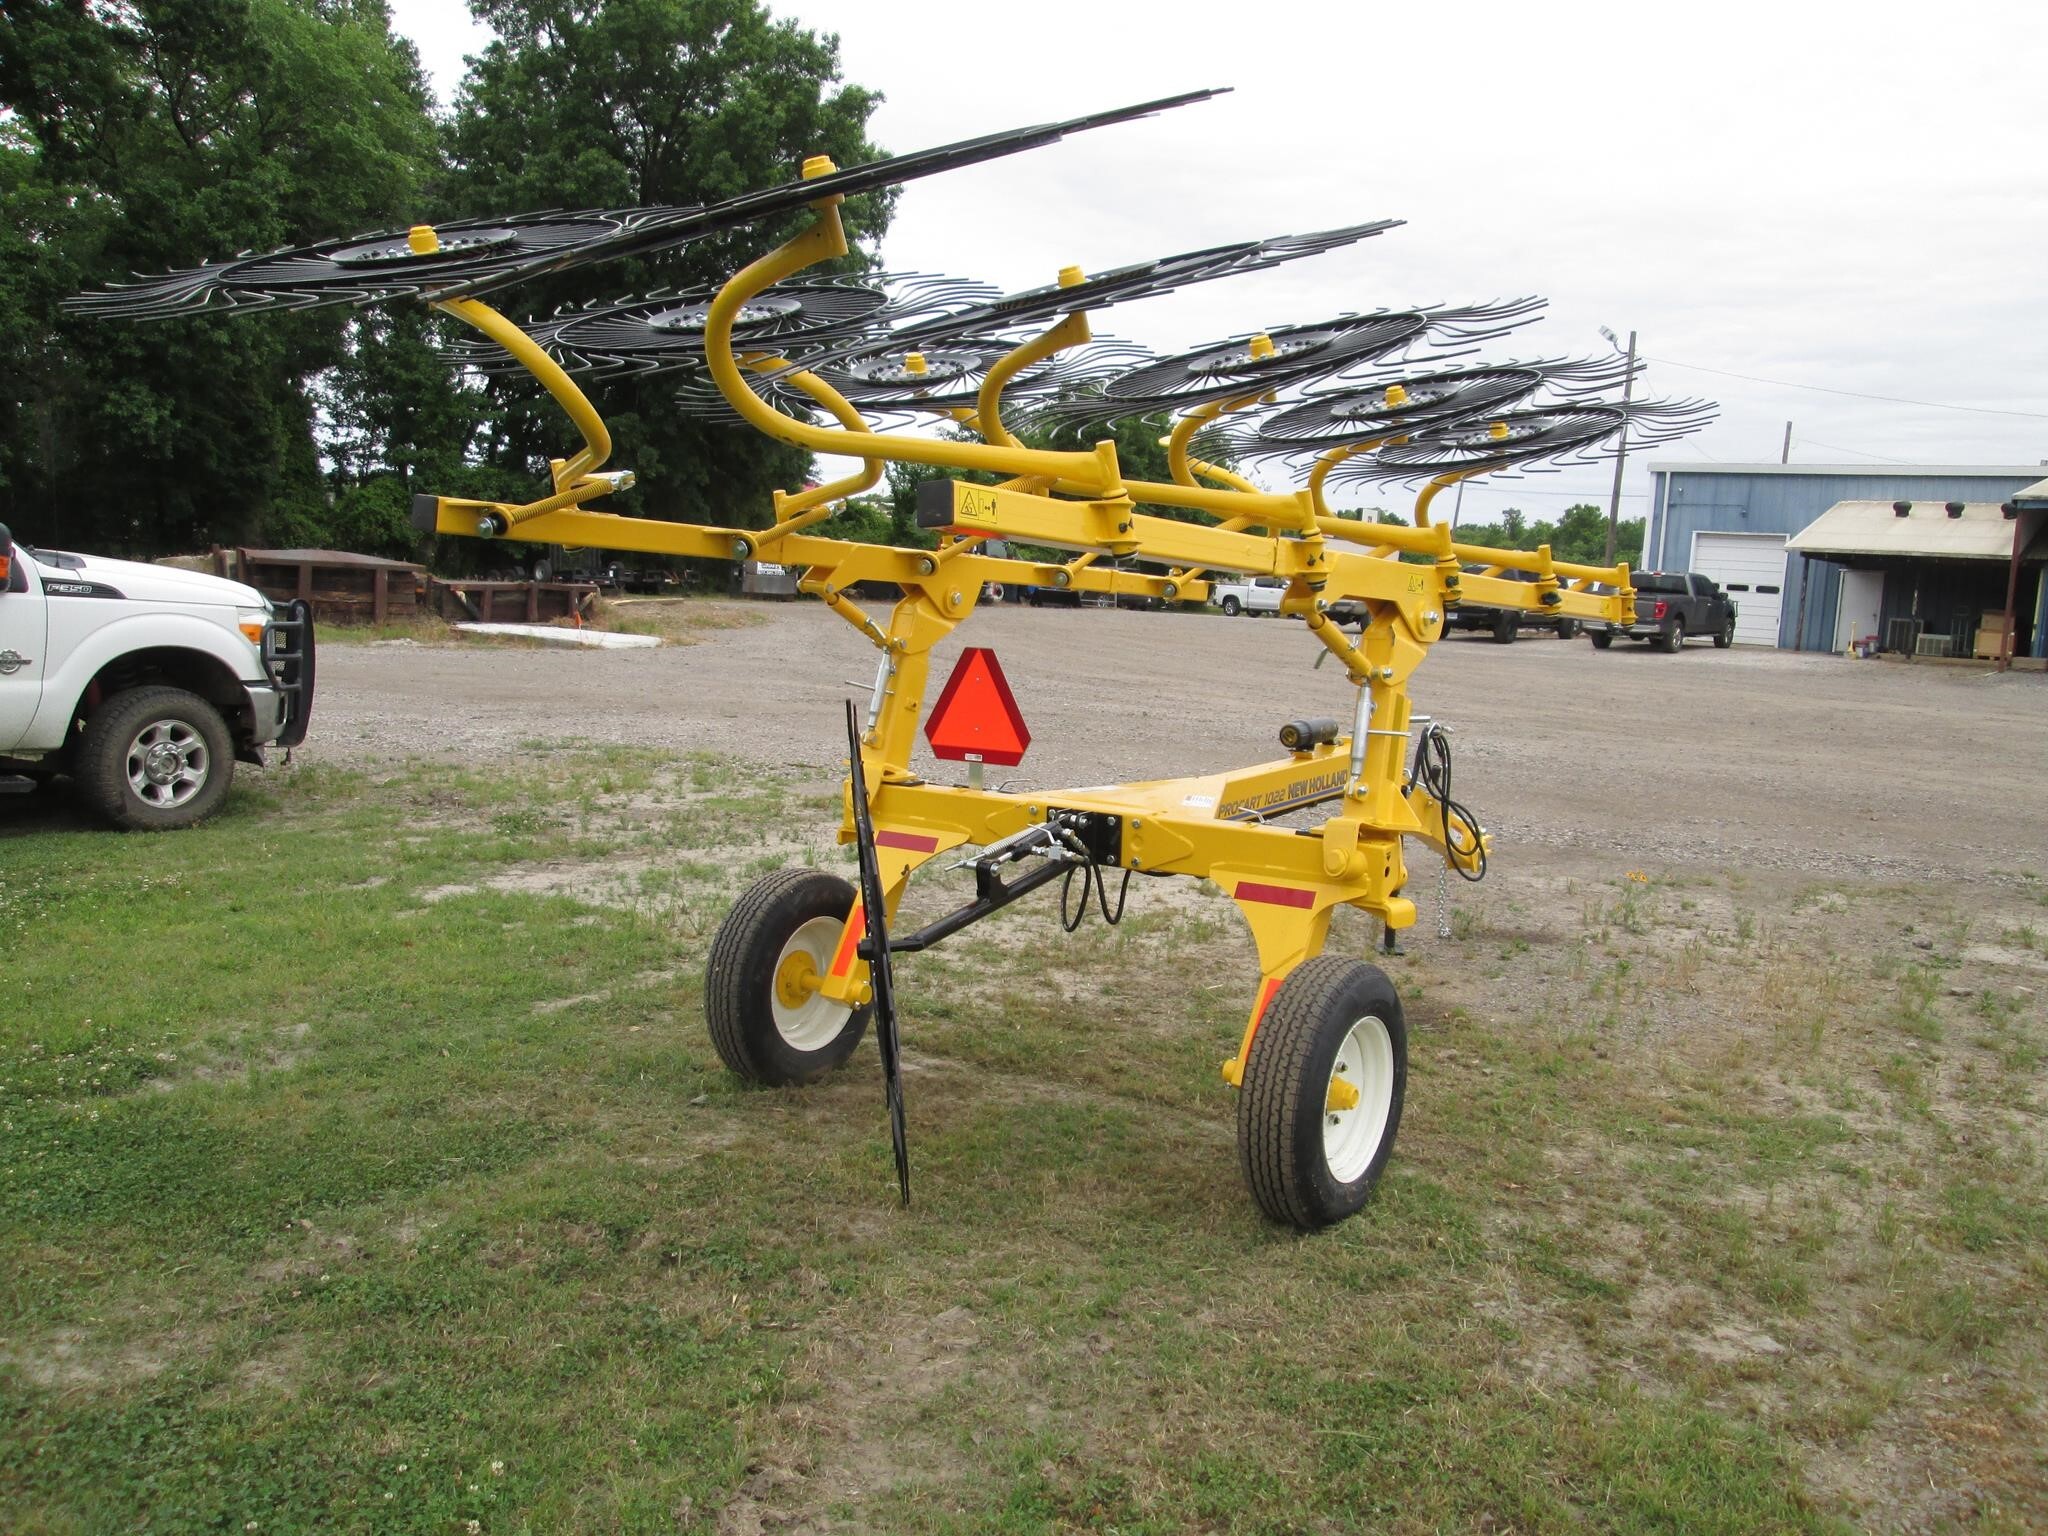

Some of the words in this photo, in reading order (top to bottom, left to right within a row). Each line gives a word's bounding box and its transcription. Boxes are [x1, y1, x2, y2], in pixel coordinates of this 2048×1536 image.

[1264, 789, 1286, 806] 1022
[1288, 780, 1308, 799] NEW
[1309, 769, 1347, 792] HOLLAND
